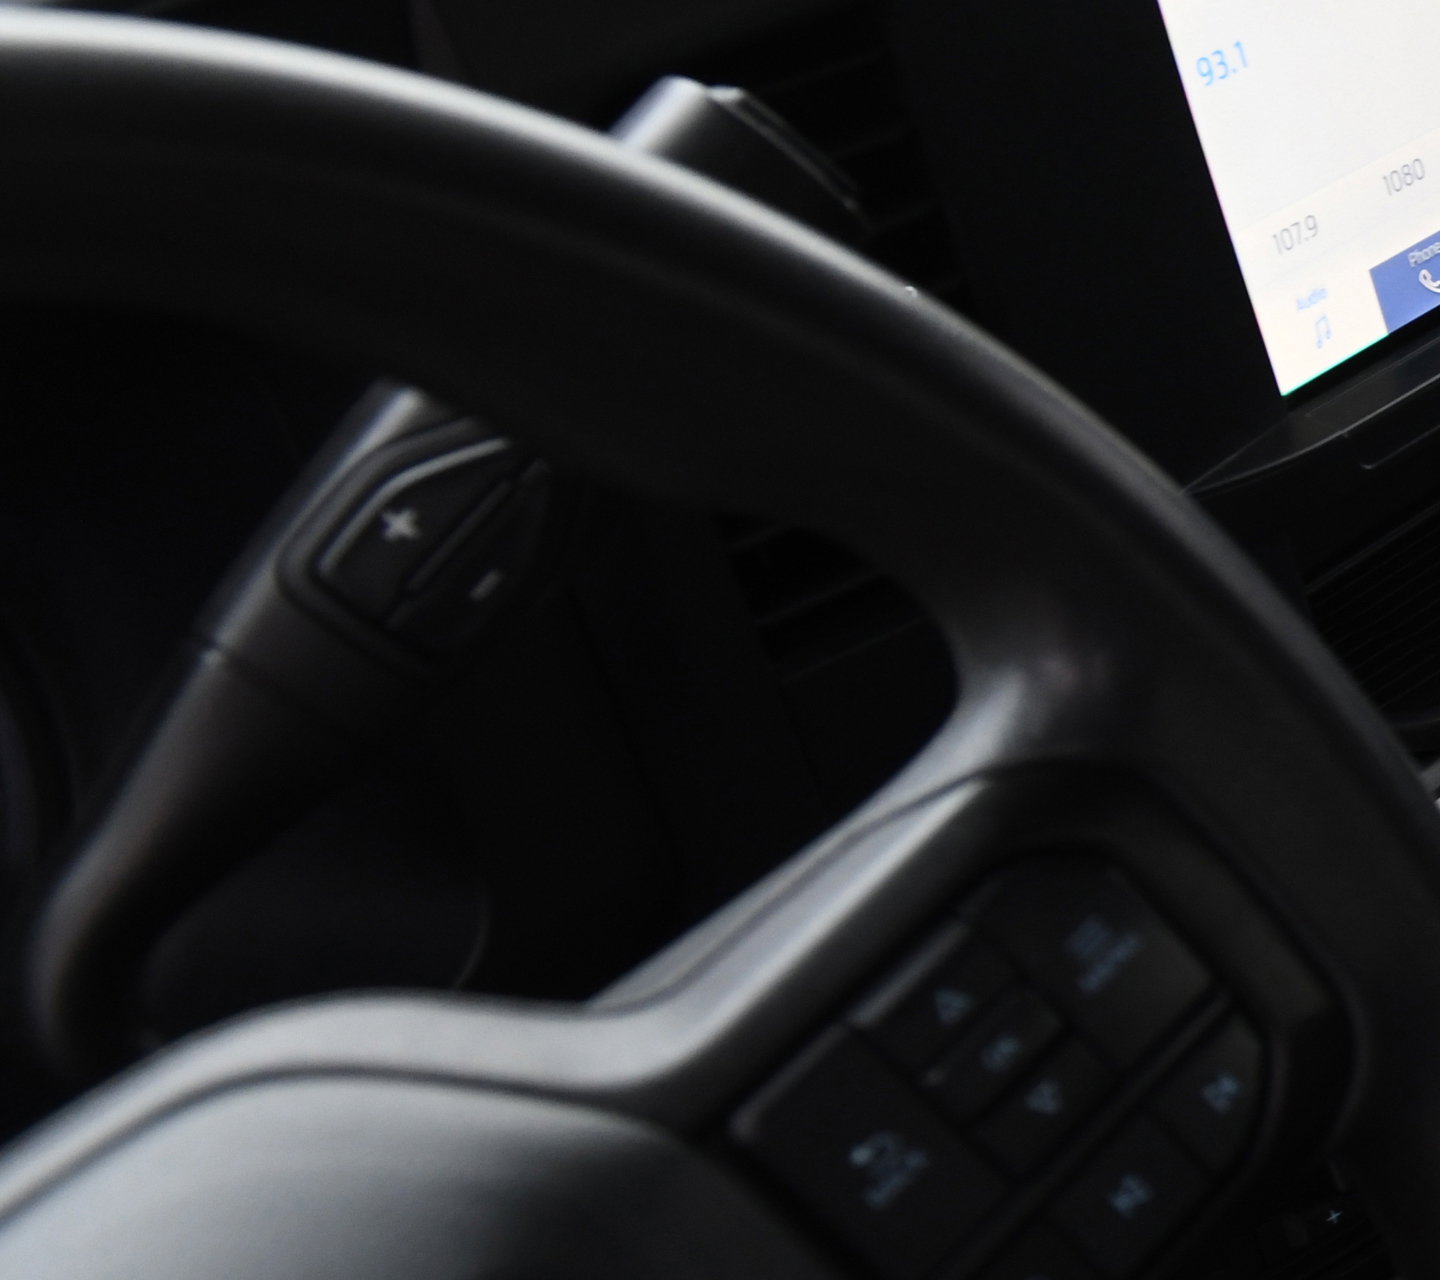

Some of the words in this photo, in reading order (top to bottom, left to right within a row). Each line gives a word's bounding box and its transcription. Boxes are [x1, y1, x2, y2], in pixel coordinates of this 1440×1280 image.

[1195, 39, 1250, 88] 93.1
[1382, 157, 1427, 197] 1080
[1271, 213, 1320, 256] 107.9
